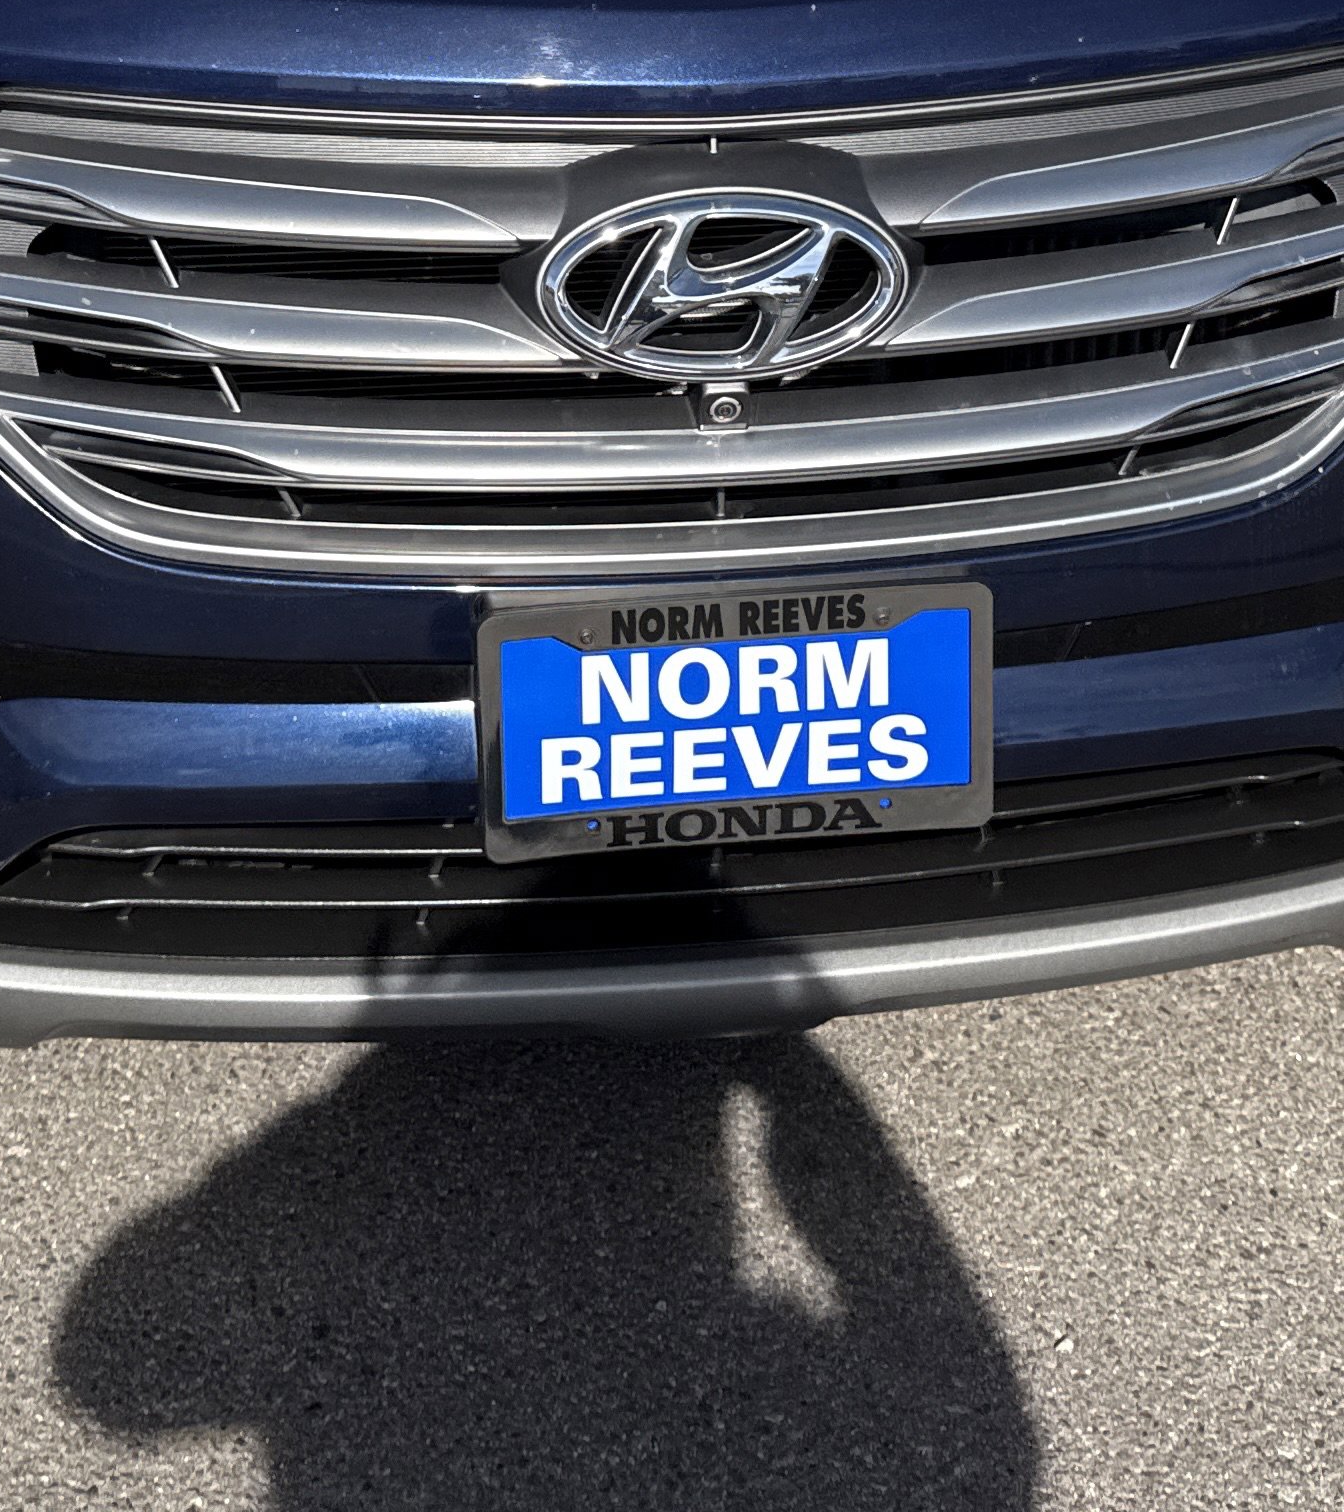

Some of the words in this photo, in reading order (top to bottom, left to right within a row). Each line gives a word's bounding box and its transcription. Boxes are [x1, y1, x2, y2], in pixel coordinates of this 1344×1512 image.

[611, 603, 724, 645] NORM
[739, 594, 866, 636] REEVES
[581, 638, 889, 725] NORM
[541, 714, 929, 805] REEVES
[606, 798, 882, 847] HONDA
